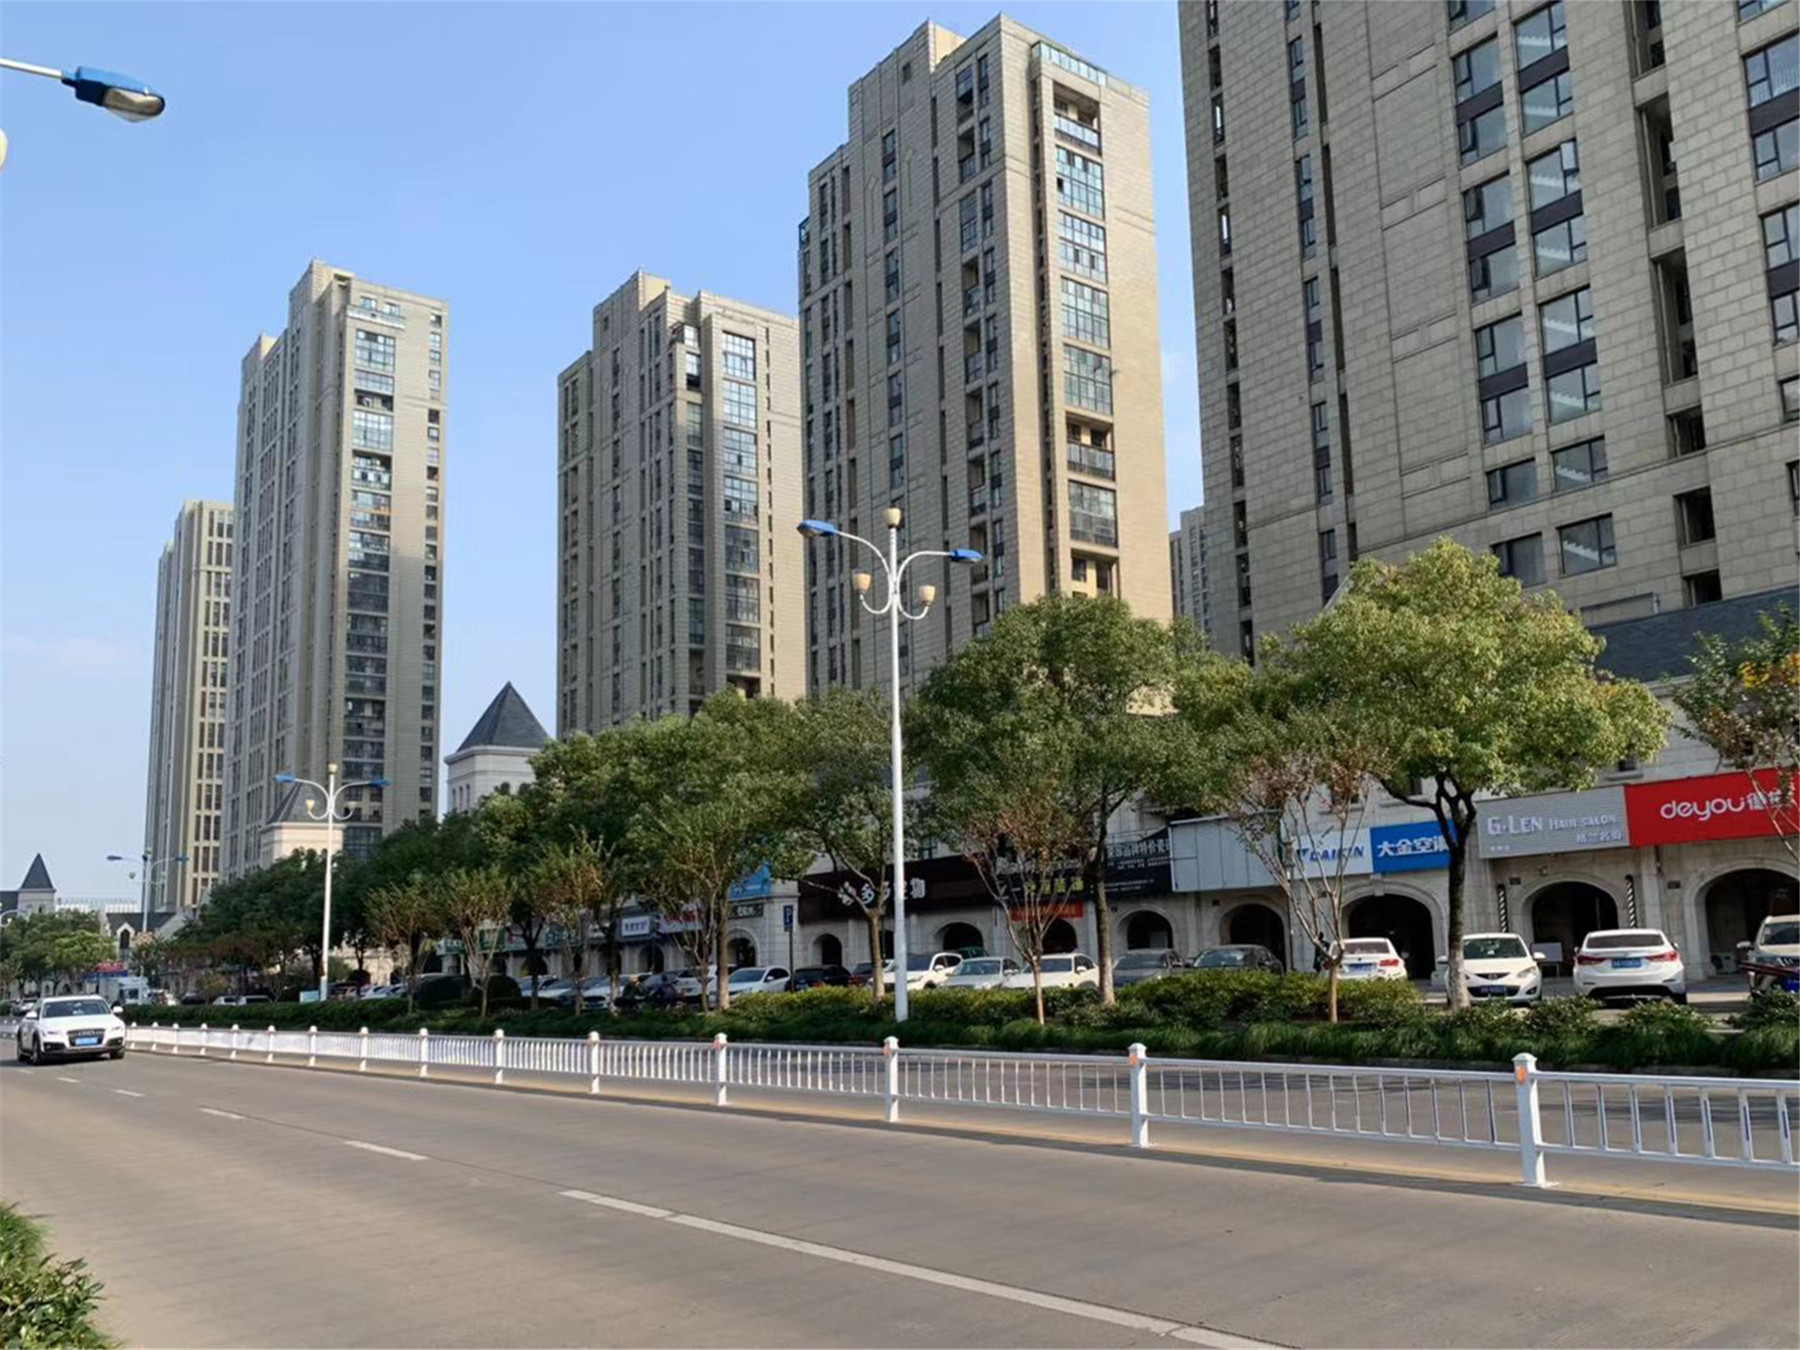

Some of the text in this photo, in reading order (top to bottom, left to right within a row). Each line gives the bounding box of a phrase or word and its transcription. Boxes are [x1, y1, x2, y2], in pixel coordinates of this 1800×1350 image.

[1659, 797, 1745, 821] deyou
[1377, 835, 1450, 858] 大金空调
